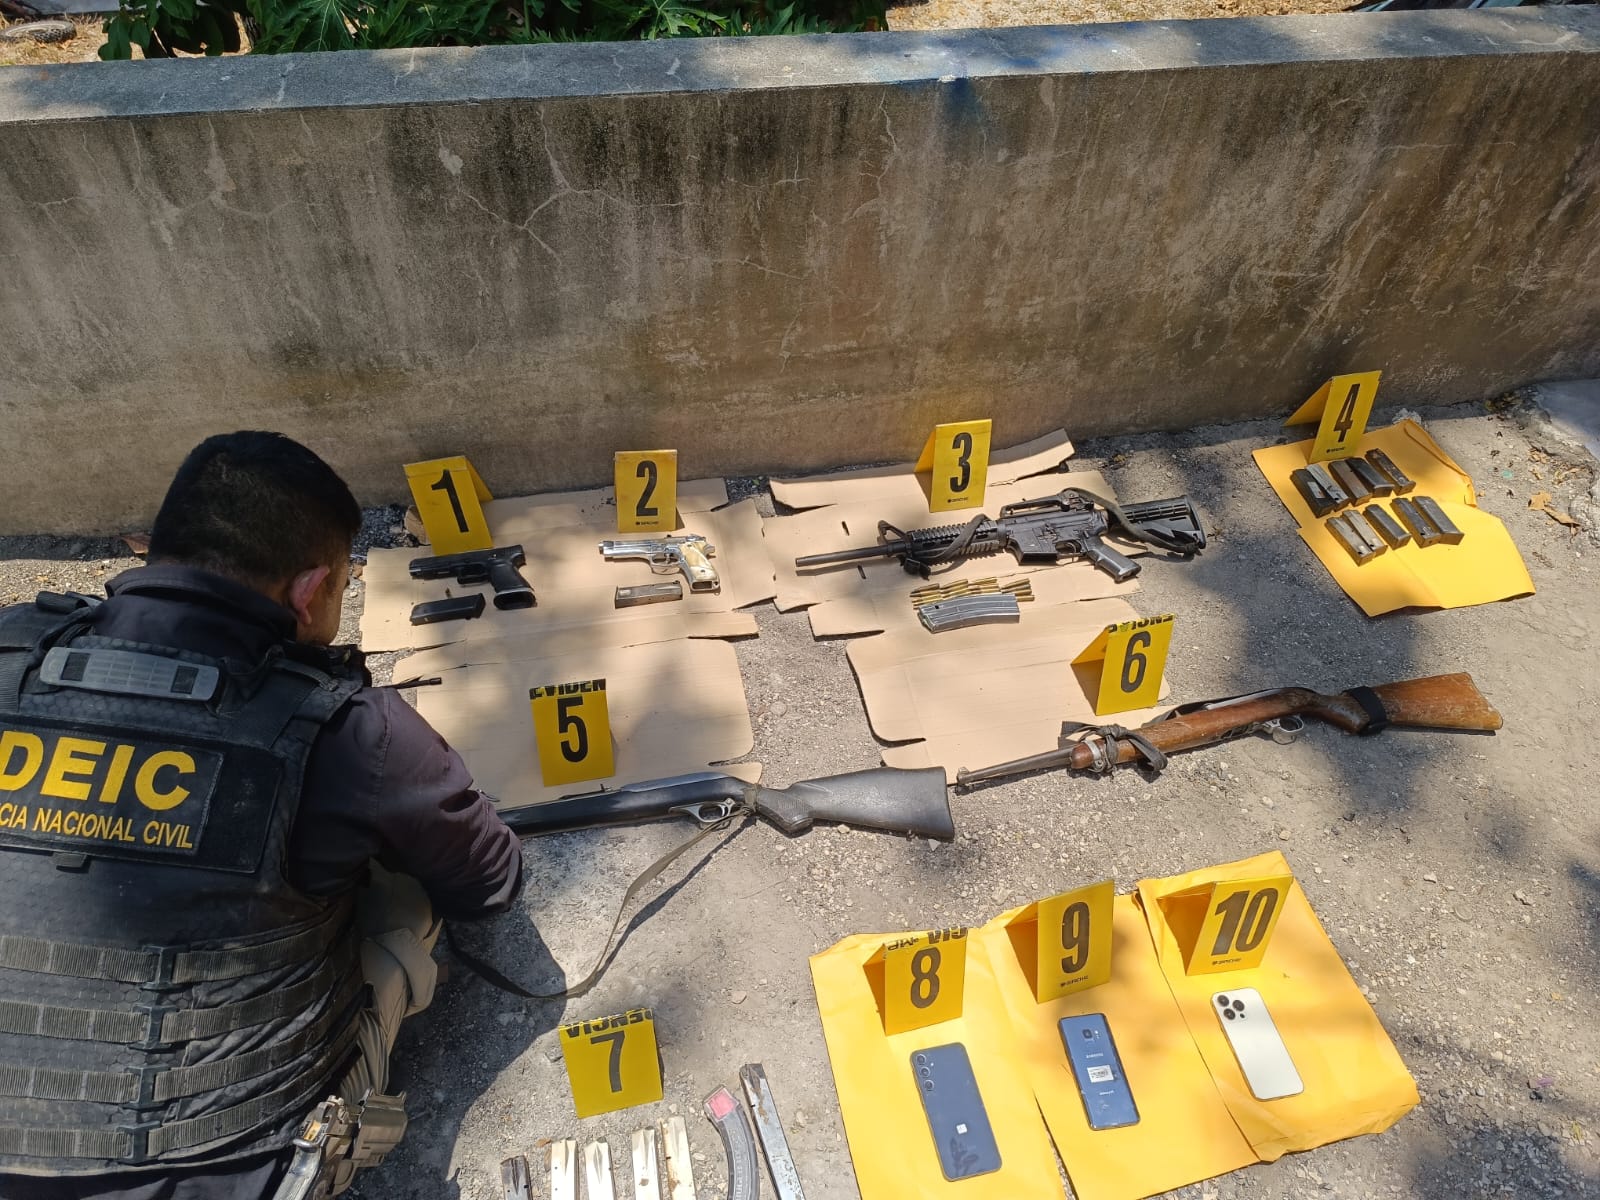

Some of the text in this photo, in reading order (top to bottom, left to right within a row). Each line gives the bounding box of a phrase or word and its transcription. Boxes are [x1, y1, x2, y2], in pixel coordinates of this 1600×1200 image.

[1333, 383, 1361, 443] 4
[635, 459, 660, 518] 2
[949, 432, 973, 494] 3
[430, 468, 470, 534] 1
[1120, 630, 1152, 694] 6
[556, 695, 589, 764] 5
[0, 730, 196, 811] DEIC
[32, 807, 136, 841] NACIONAL
[143, 821, 194, 849] CIVIL
[1062, 901, 1091, 974] 9
[1211, 887, 1279, 956] 10
[910, 946, 942, 1009] 8
[590, 1030, 626, 1093] 7
